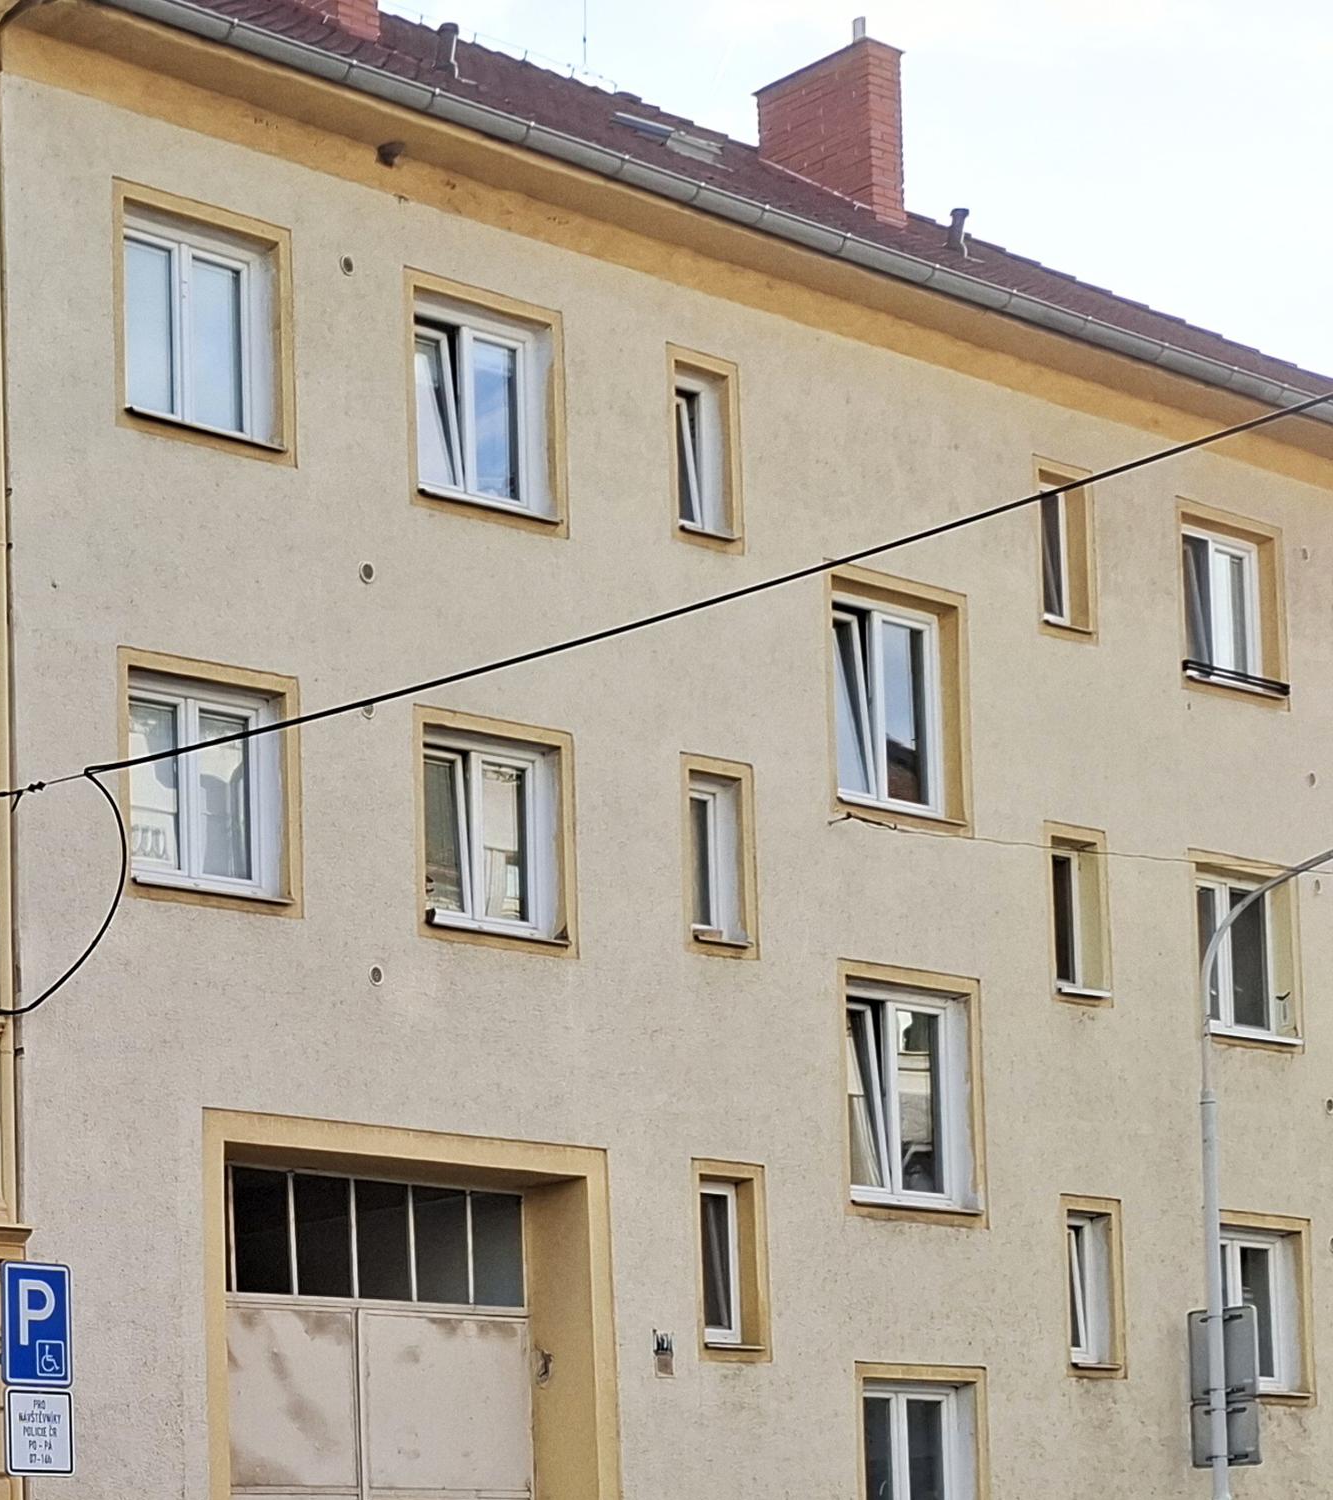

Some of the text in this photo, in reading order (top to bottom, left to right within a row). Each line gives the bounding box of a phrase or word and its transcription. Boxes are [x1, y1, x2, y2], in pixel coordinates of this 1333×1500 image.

[18, 1278, 56, 1346] P
[33, 1399, 46, 1410] PRO
[23, 1425, 47, 1437] POLICIE
[28, 1439, 37, 1451] PO
